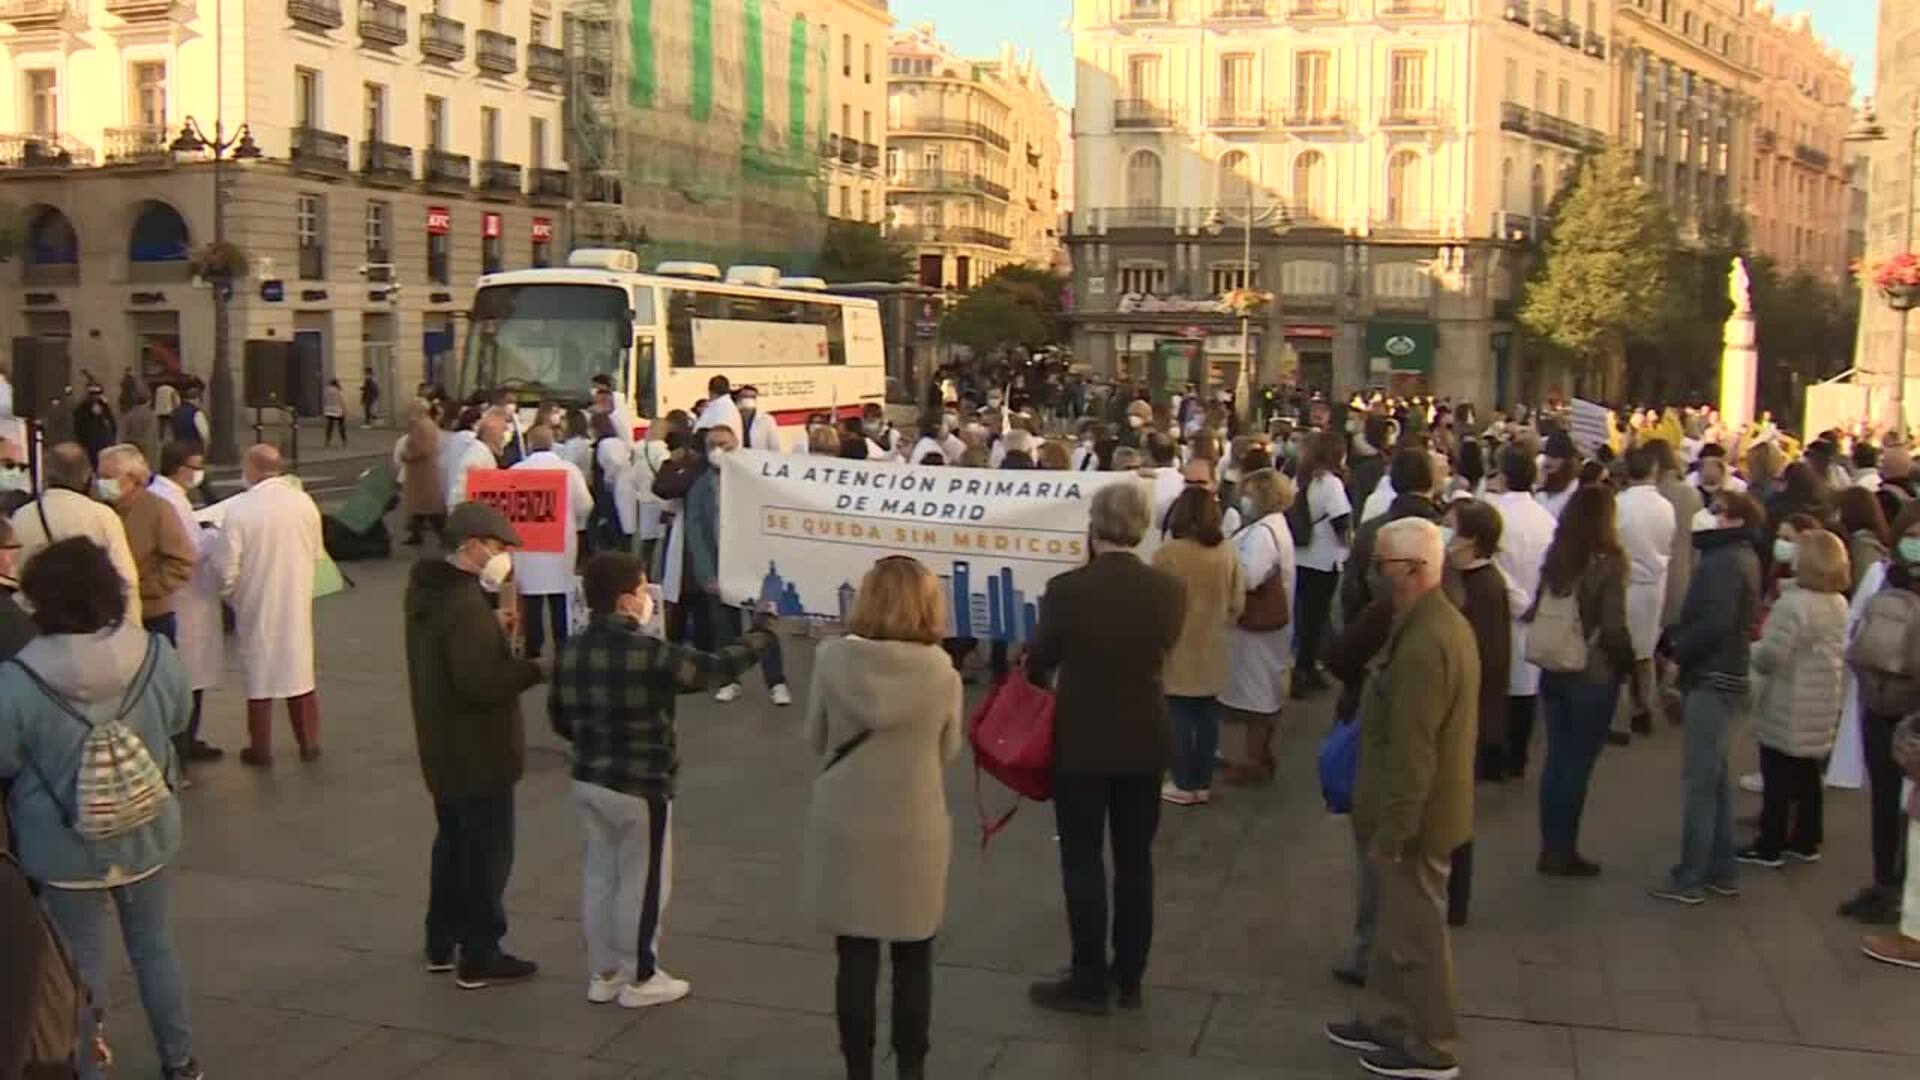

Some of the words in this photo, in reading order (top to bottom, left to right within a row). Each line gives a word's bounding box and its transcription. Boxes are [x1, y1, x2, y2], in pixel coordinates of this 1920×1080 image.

[761, 461, 790, 478] LA
[803, 467, 935, 493] ATENCIÓN
[948, 479, 1081, 499] PRIMARIA
[836, 494, 869, 511] DE
[880, 499, 985, 520] MADRID
[767, 515, 789, 529] SE
[802, 518, 880, 540] QUEDA
[895, 527, 936, 544] SIN
